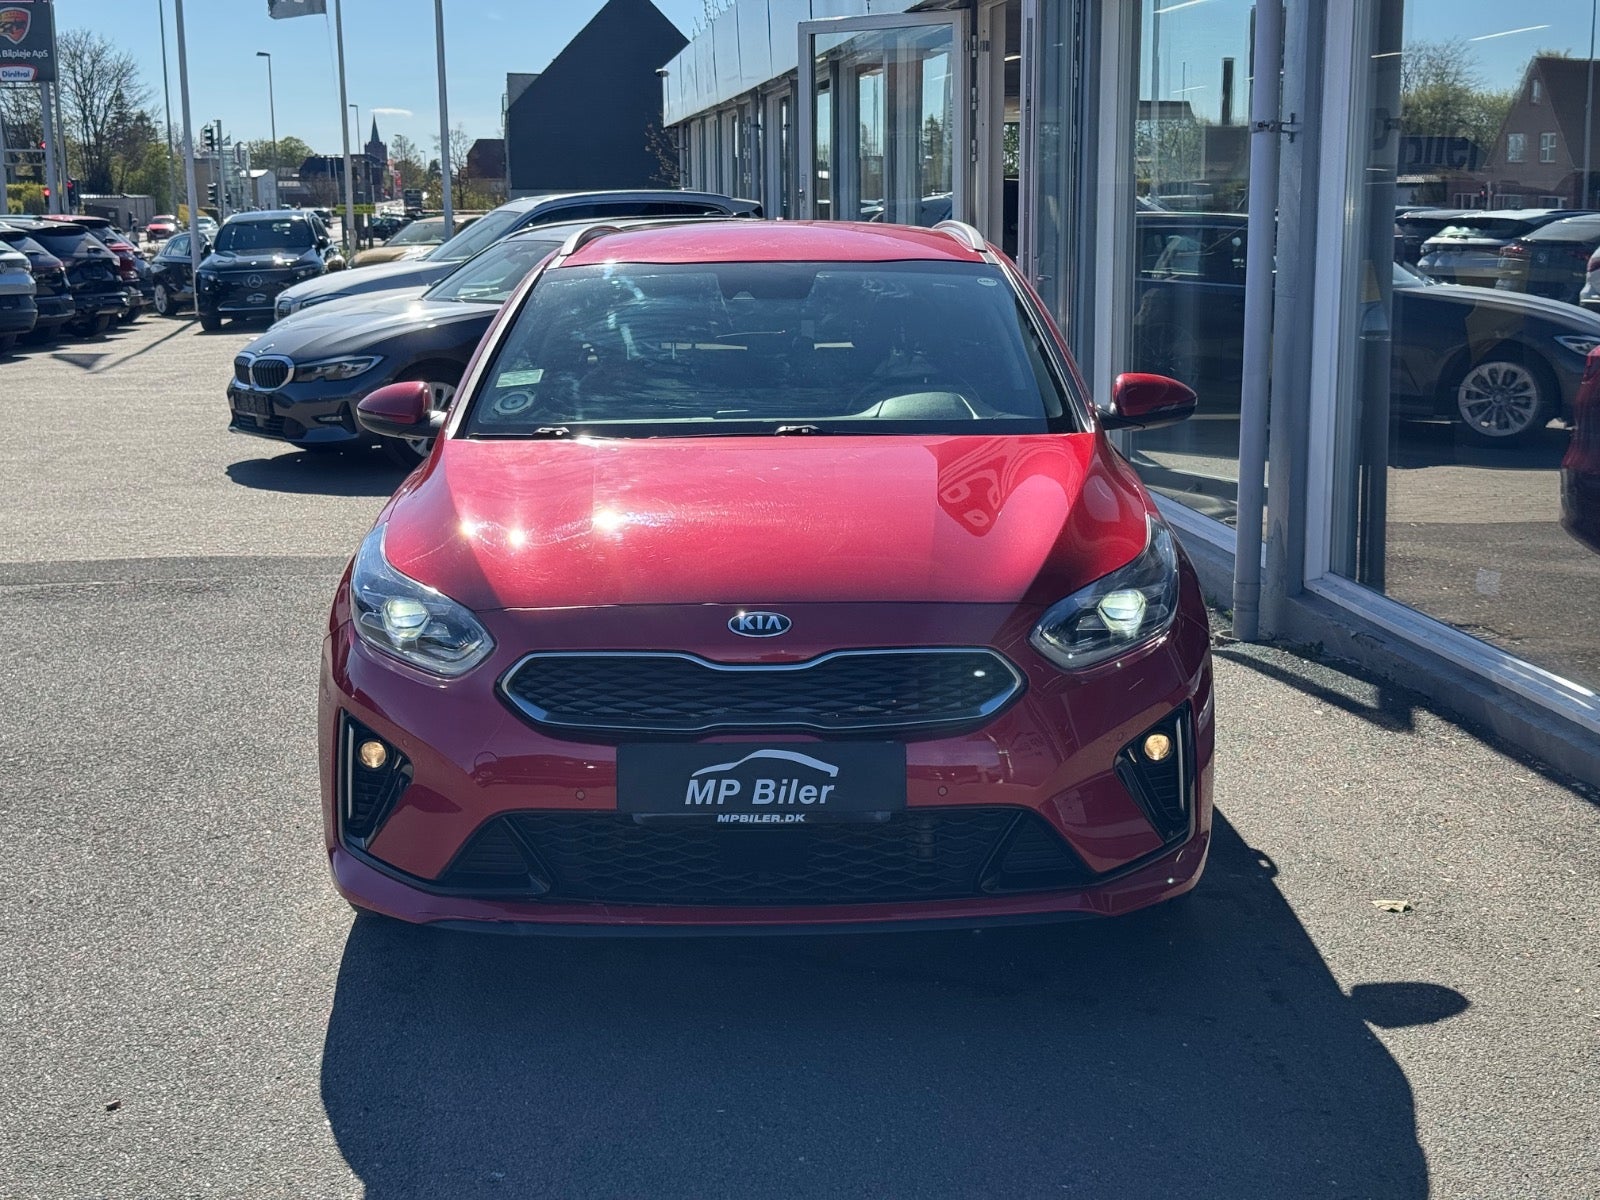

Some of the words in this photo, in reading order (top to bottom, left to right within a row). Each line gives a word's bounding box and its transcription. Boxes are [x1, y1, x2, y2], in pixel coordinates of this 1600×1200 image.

[32, 49, 49, 59] ApS
[2, 70, 30, 78] Dinitrol
[739, 616, 782, 630] KIA
[685, 779, 741, 805] MP
[752, 779, 835, 805] Biler
[717, 814, 806, 823] MPBILER.DK
